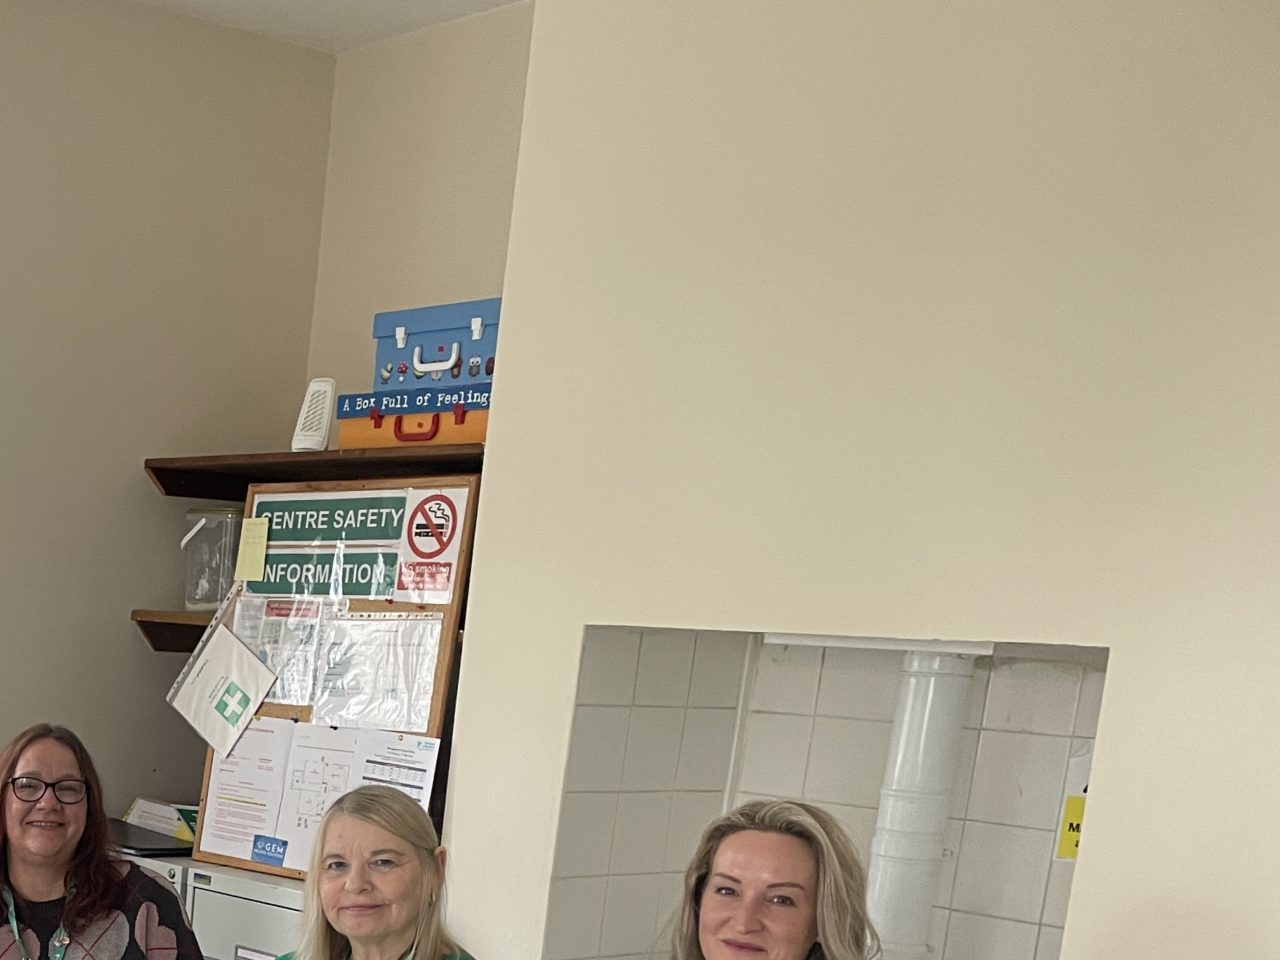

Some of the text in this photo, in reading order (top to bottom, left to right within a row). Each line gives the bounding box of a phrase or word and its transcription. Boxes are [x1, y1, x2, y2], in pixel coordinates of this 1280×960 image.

[343, 390, 491, 411] A Box Full of Feeling
[333, 508, 404, 529] SAFETY
[263, 563, 385, 583] NFORMTION
[415, 563, 450, 576] smoking
[265, 843, 284, 854] GEM
